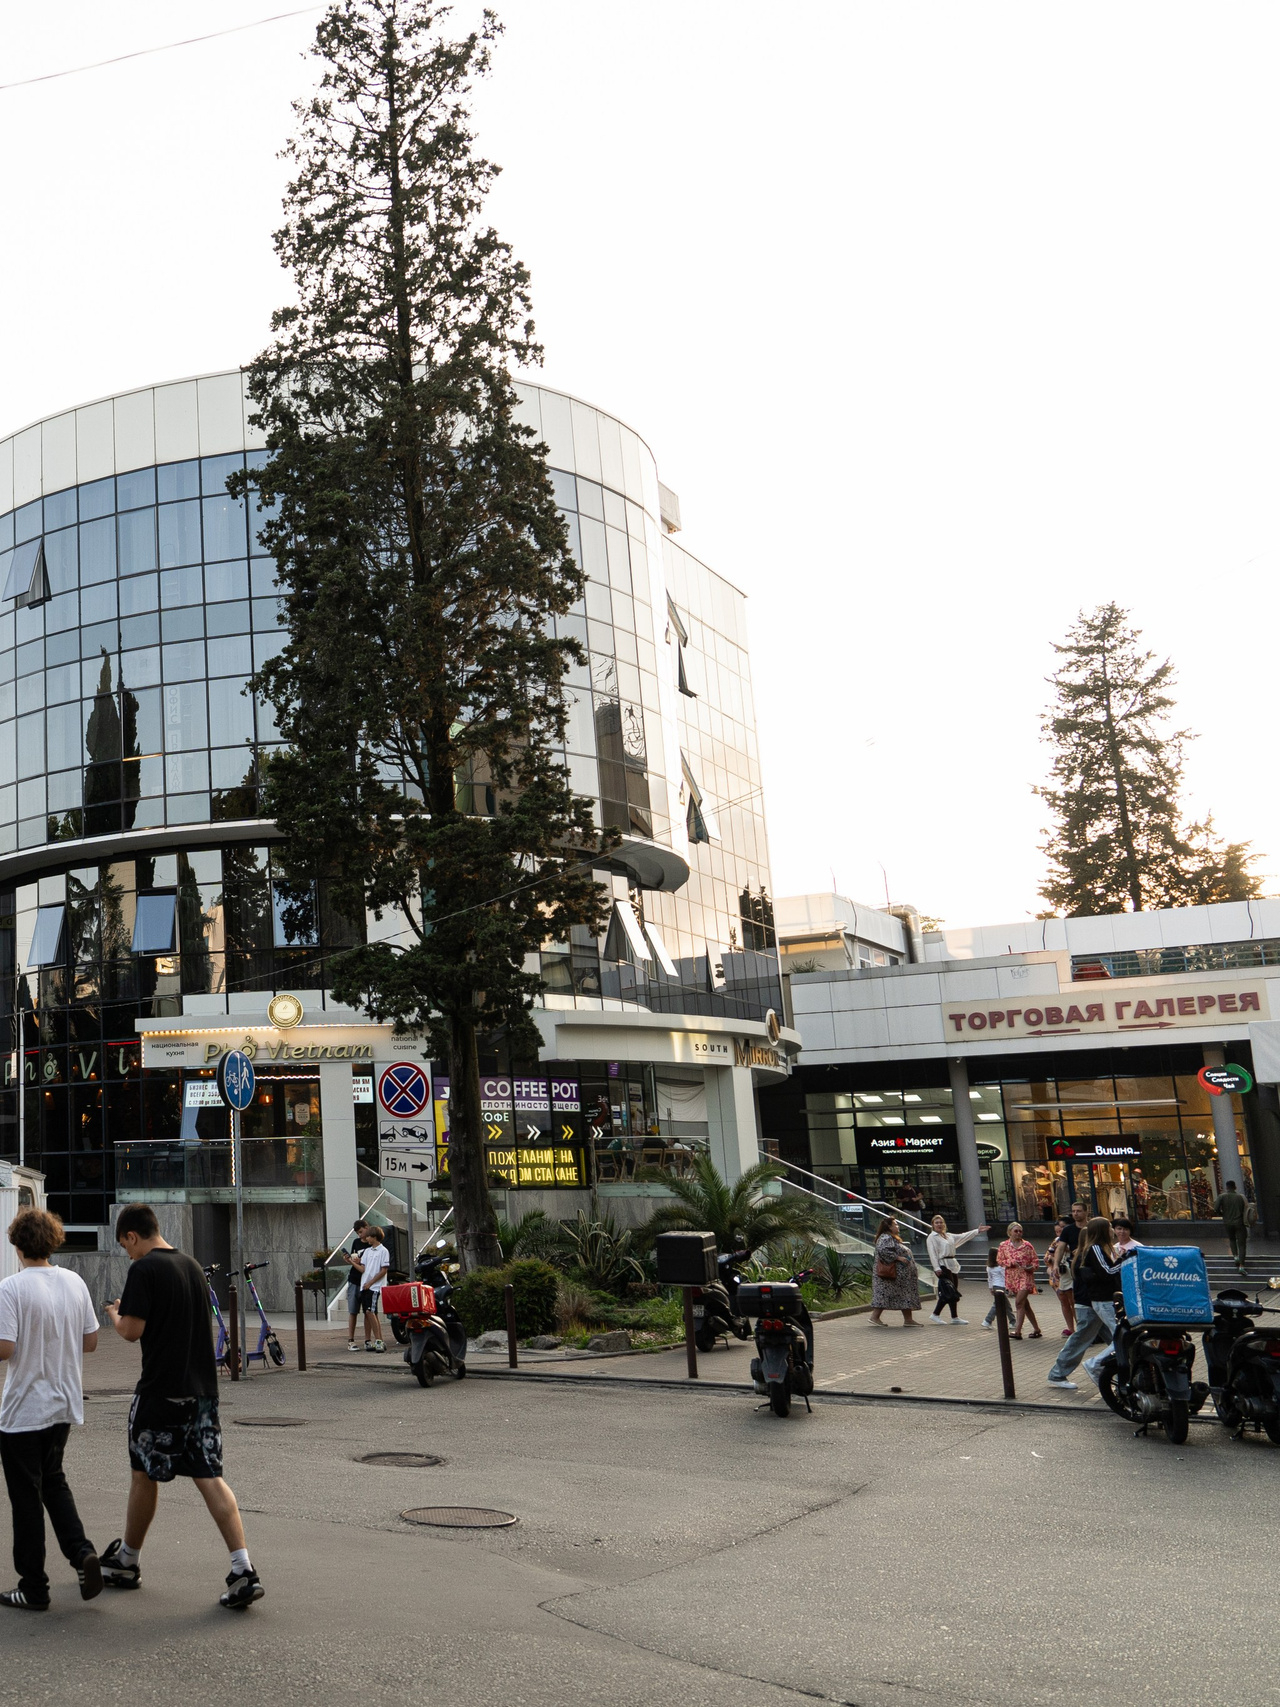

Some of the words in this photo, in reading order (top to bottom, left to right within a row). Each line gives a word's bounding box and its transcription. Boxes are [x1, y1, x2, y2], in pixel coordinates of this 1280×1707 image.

[949, 1003, 1104, 1031] ТОРГОВАЯ
[1115, 992, 1260, 1020] ГАЛЕРЕЯ
[391, 1034, 418, 1042] national
[151, 1042, 199, 1050] национальная
[265, 1039, 373, 1060] Vietnam
[695, 1043, 728, 1053] SOUTH
[484, 1080, 548, 1098] COFFEE
[552, 1082, 578, 1098] POT
[871, 1138, 896, 1147] Азия
[905, 1137, 943, 1147] Маркет
[560, 1149, 574, 1163] НА
[1095, 1145, 1134, 1155] Вишня
[534, 1167, 579, 1181] СТАКАНЕ
[1142, 1268, 1202, 1282] Сицилия
